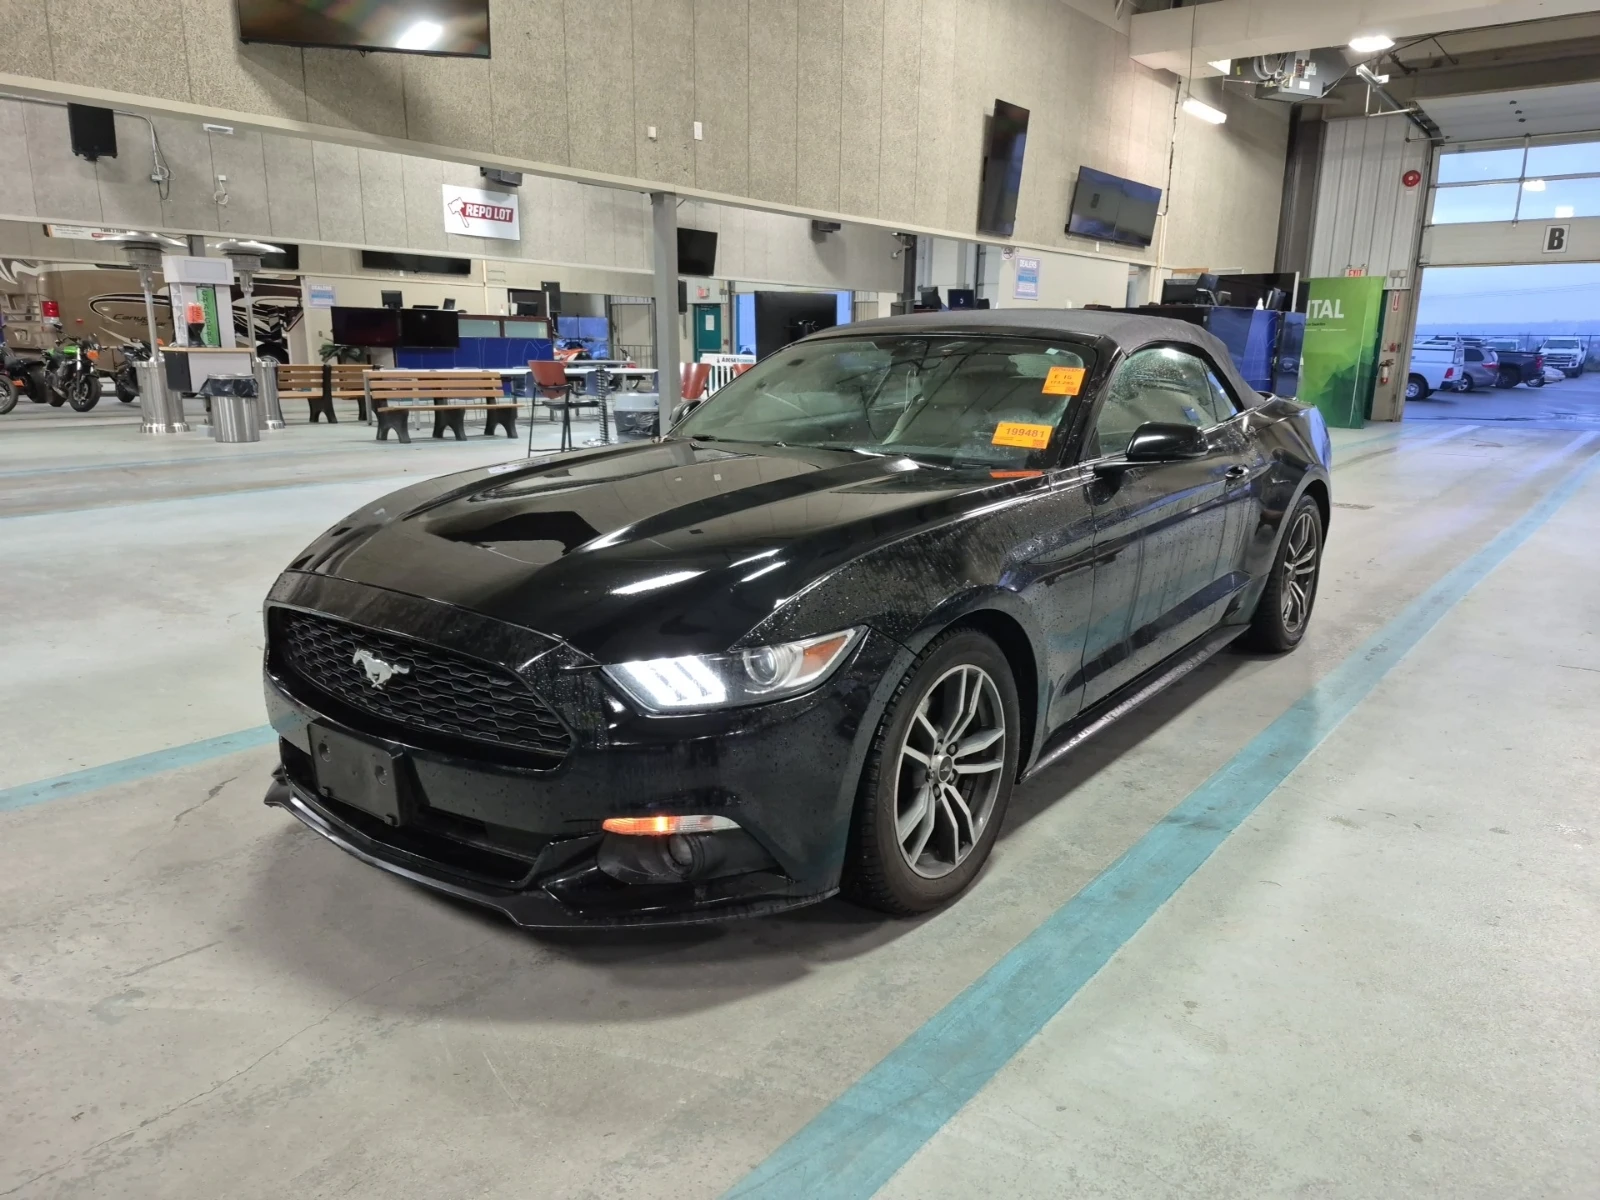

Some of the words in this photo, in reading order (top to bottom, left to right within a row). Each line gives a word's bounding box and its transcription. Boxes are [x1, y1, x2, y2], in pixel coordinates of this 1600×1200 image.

[465, 203, 492, 218] REPO
[494, 207, 511, 221] LOT
[1547, 227, 1565, 250] B
[1020, 259, 1037, 269] DEALERS
[1006, 427, 1045, 438] 199481
